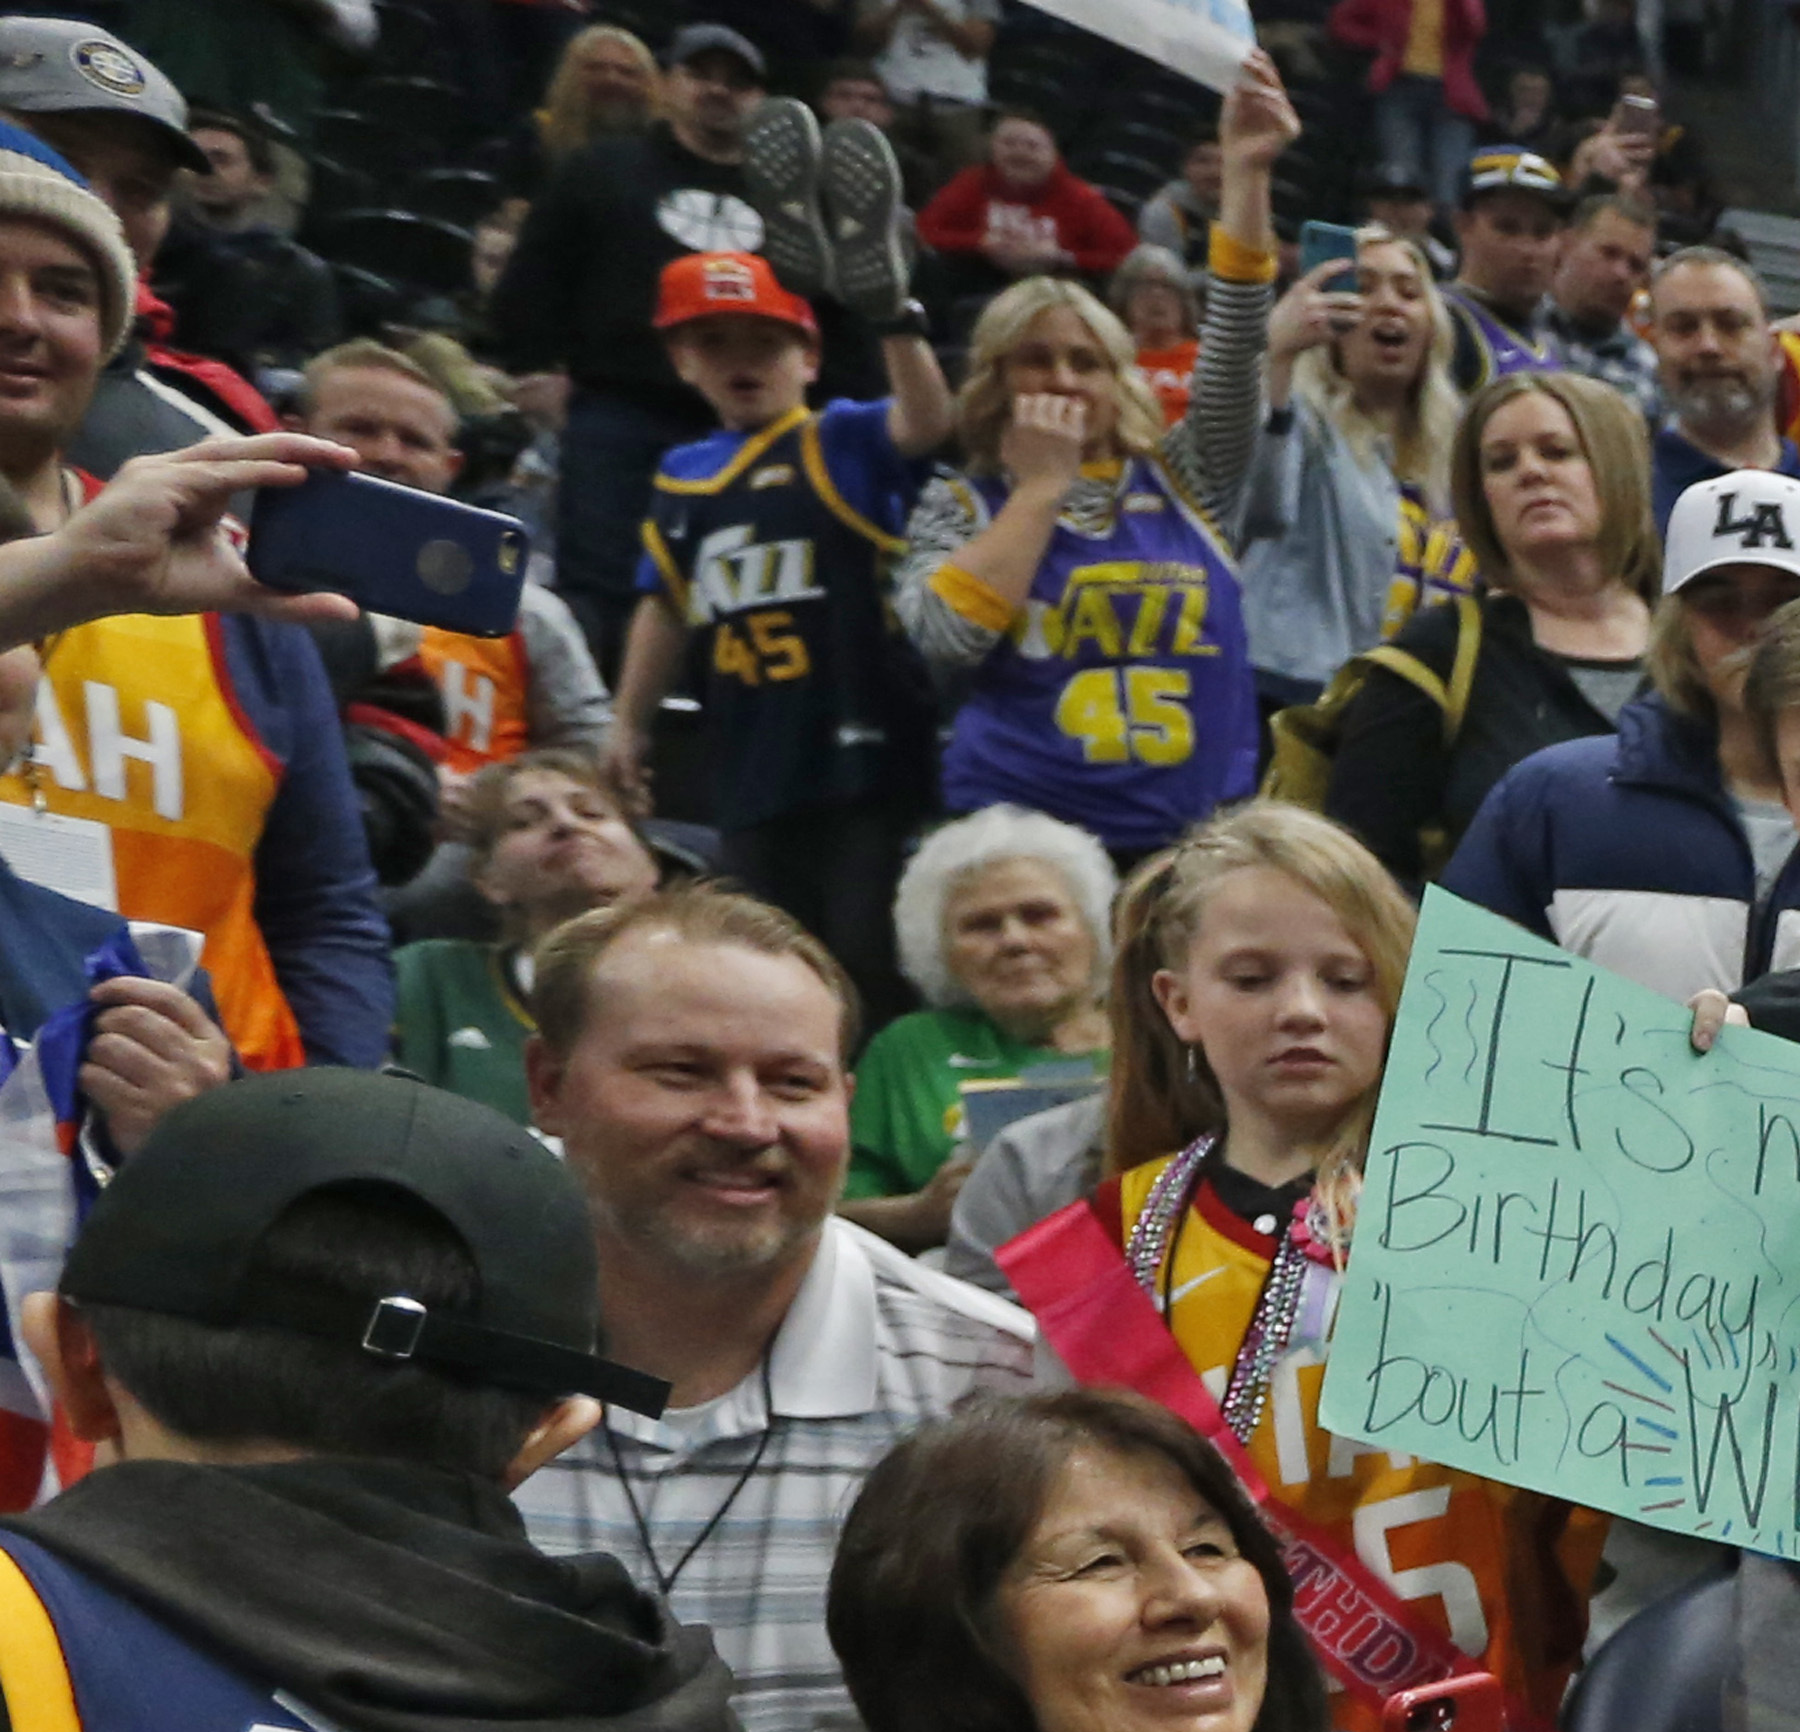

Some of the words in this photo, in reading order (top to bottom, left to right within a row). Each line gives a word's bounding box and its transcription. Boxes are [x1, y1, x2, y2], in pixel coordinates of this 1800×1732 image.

[1712, 492, 1795, 550] LA
[714, 610, 812, 686] 45
[29, 675, 185, 822] AH
[1054, 664, 1197, 768] 45
[1418, 947, 1696, 1173] It's
[1576, 1400, 1630, 1488] a
[1352, 1484, 1489, 1659] 5
